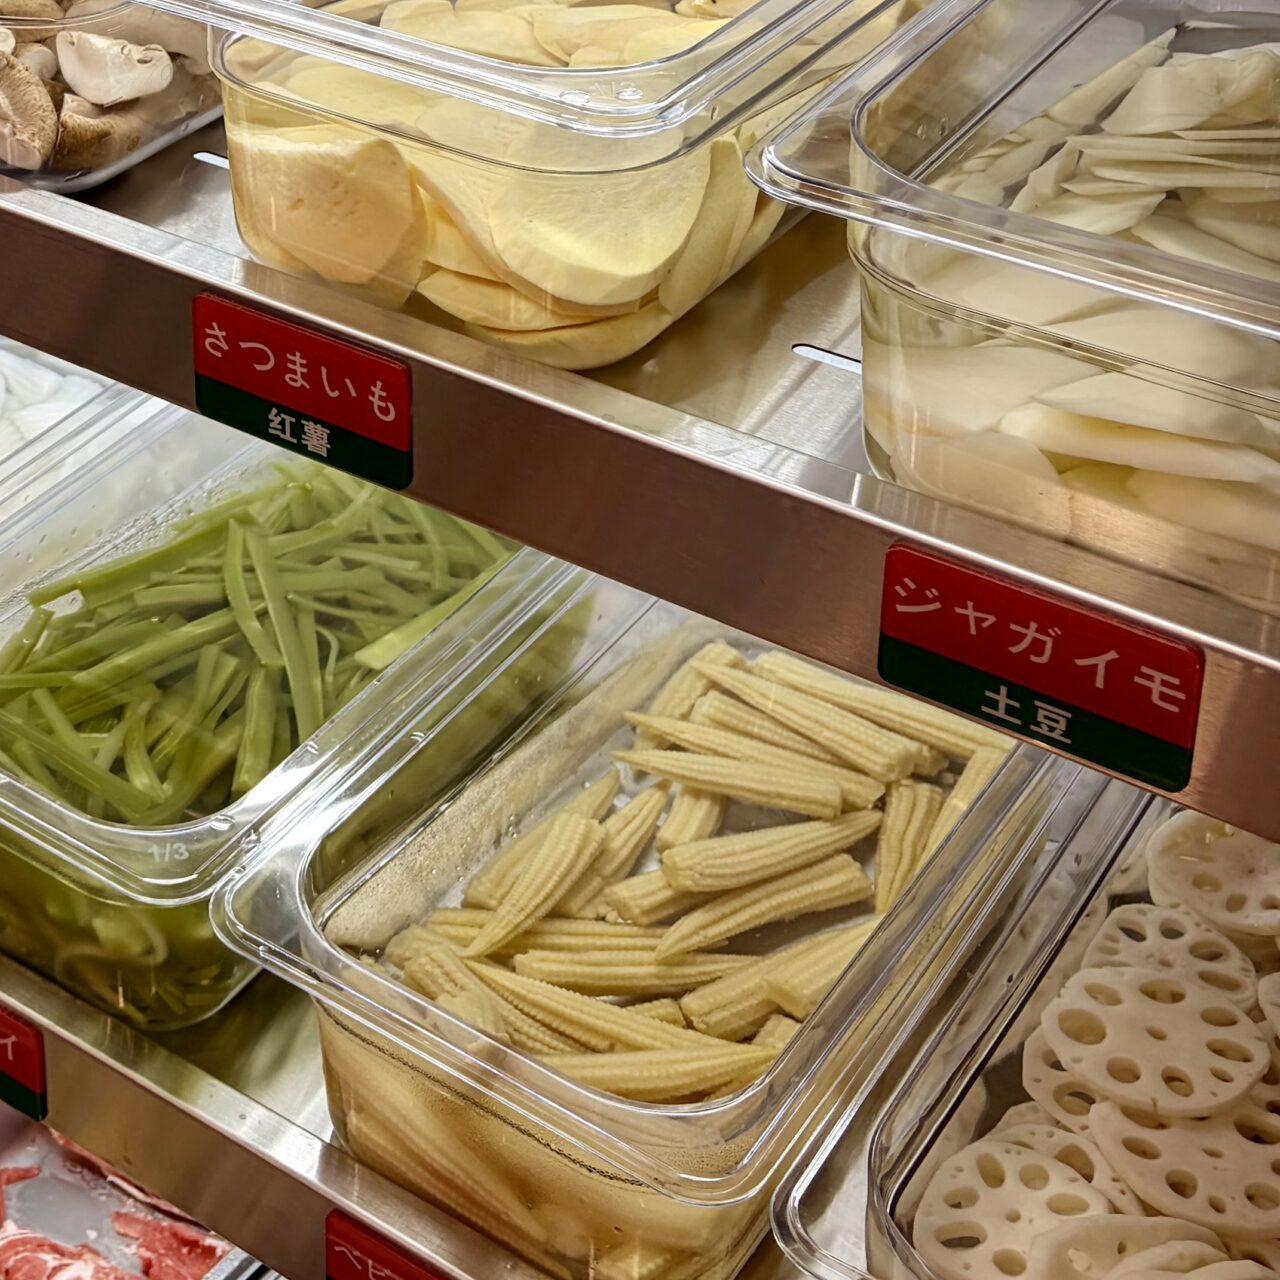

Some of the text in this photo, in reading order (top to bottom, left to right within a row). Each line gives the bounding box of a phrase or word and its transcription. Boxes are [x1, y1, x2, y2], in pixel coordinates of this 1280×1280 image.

[204, 321, 396, 422] さつまいも
[268, 407, 331, 458] 红薯
[894, 577, 1187, 713] ジャガイモ
[980, 684, 1072, 755] 土豆
[147, 842, 190, 862] 1/3
